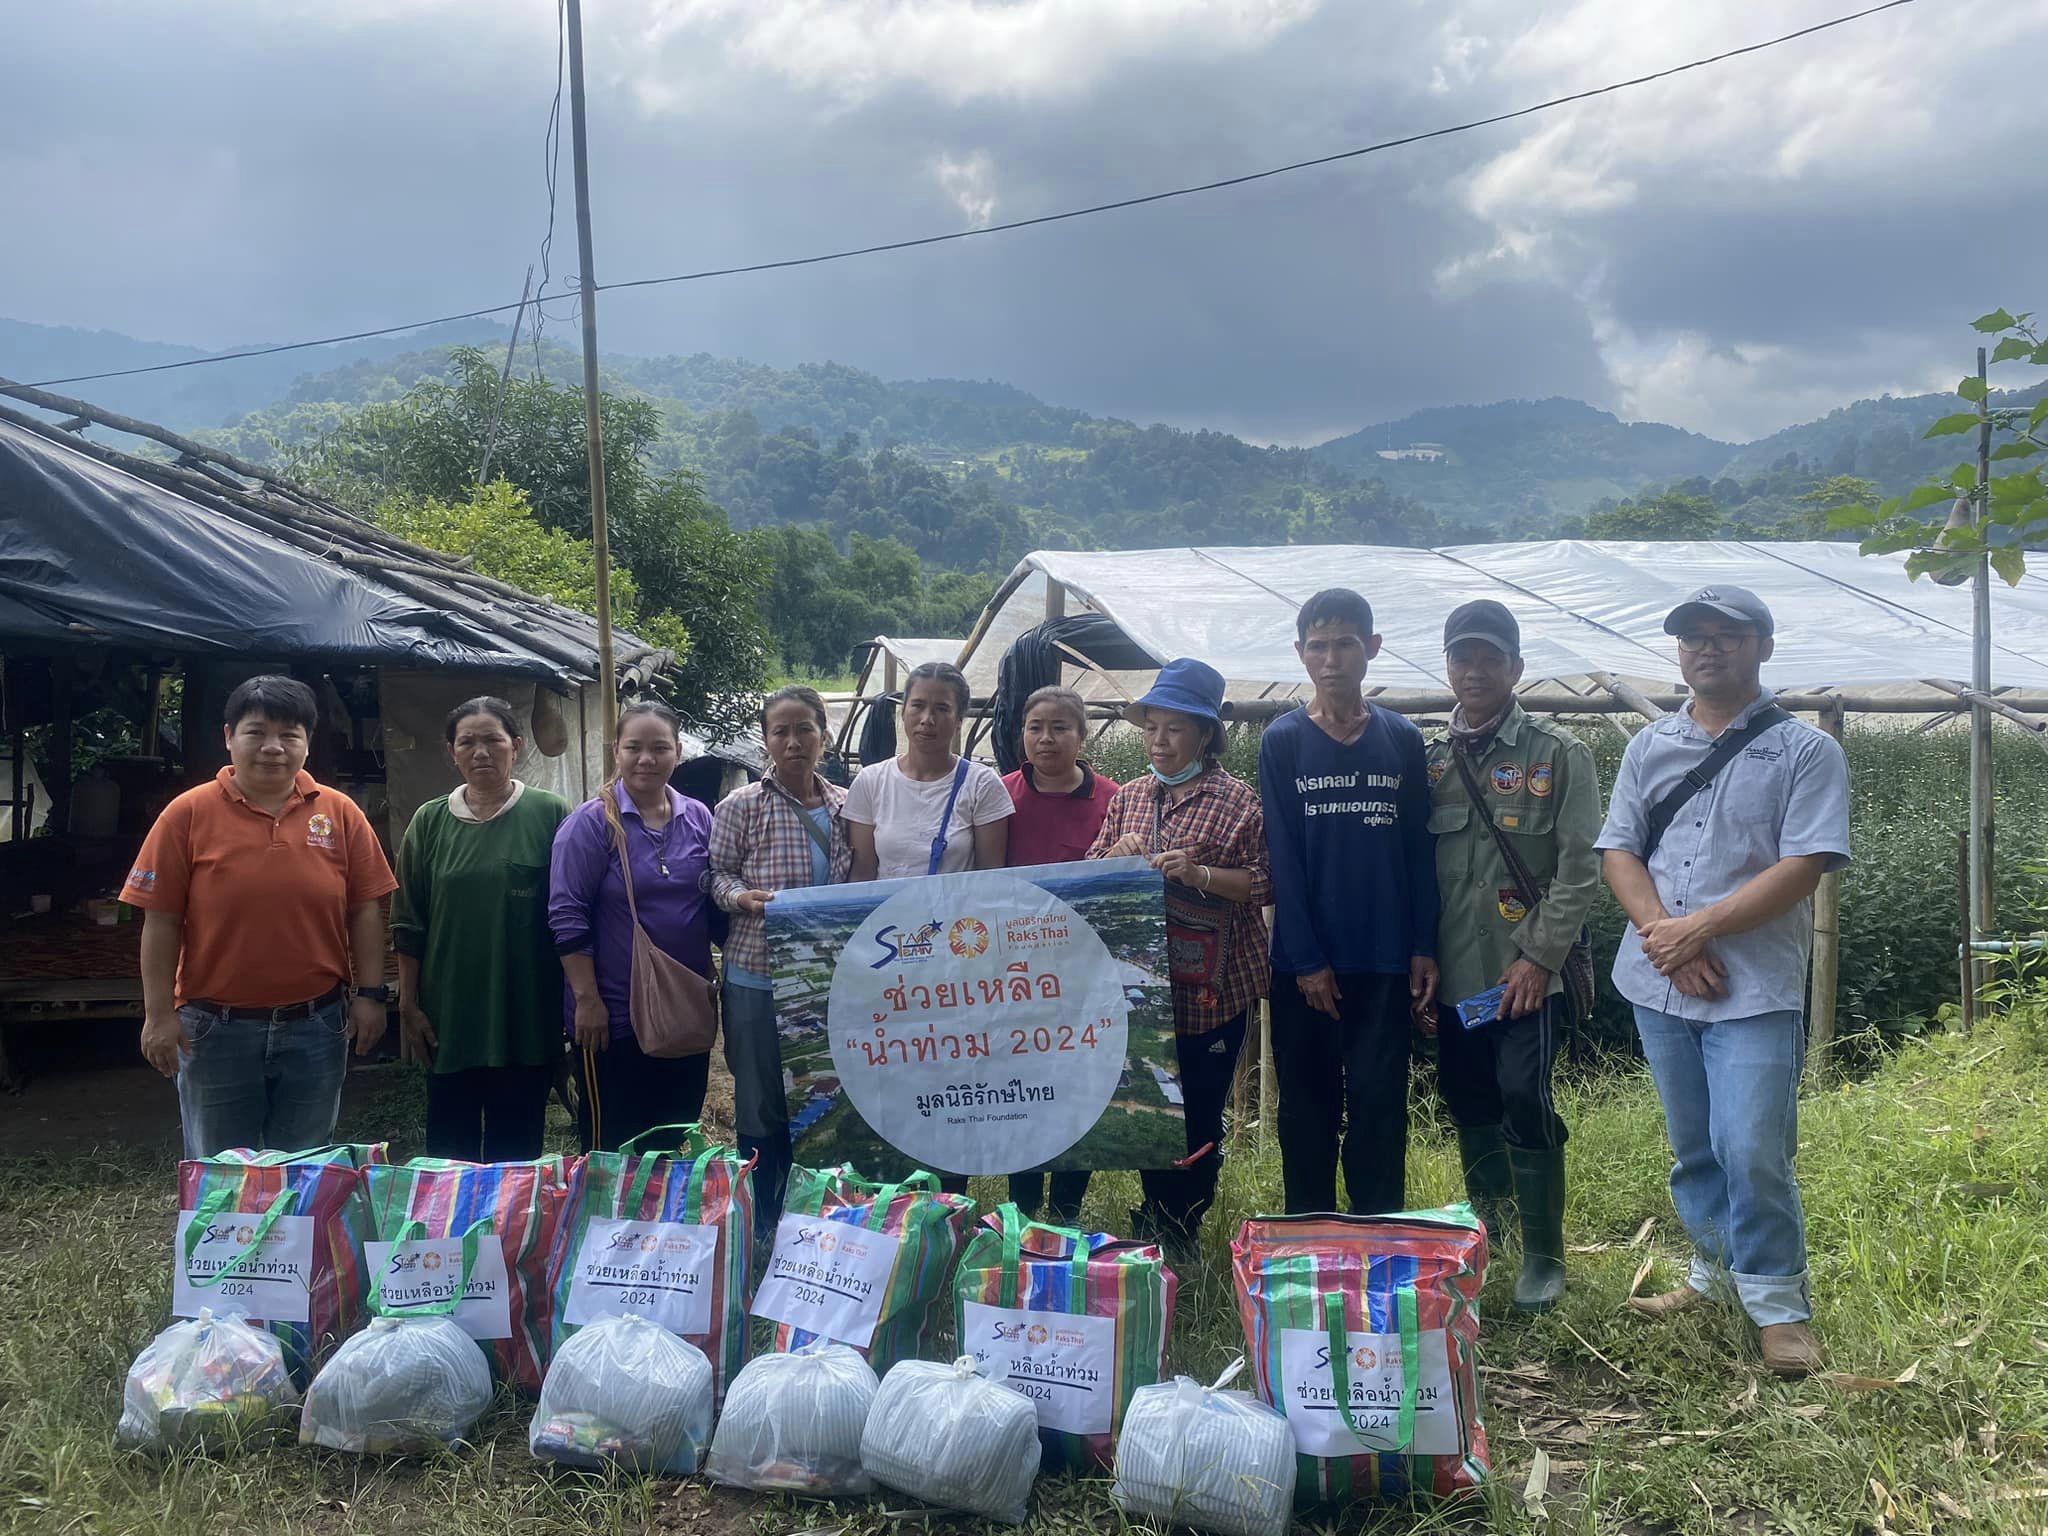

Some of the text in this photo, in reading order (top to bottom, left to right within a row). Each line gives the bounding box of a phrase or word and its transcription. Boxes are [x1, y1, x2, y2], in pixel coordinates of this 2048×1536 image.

[1008, 925, 1068, 942] Raks Thai
[883, 961, 1061, 1012] ช่วยเหลือ
[916, 1078, 1055, 1118] มูลนิธิรักษ์ไทย
[947, 1112, 1028, 1125] Raks Thai Foundation
[587, 1259, 699, 1285] ช่วยเหลือน้ำท่วม
[774, 1253, 872, 1295] ช่วยเหลือน้ำท่วม
[220, 1282, 254, 1296] 2024
[795, 1286, 825, 1306] 2024
[619, 1290, 656, 1306] 2024
[1017, 1383, 1052, 1400] 2024
[1350, 1413, 1390, 1429] 2024
